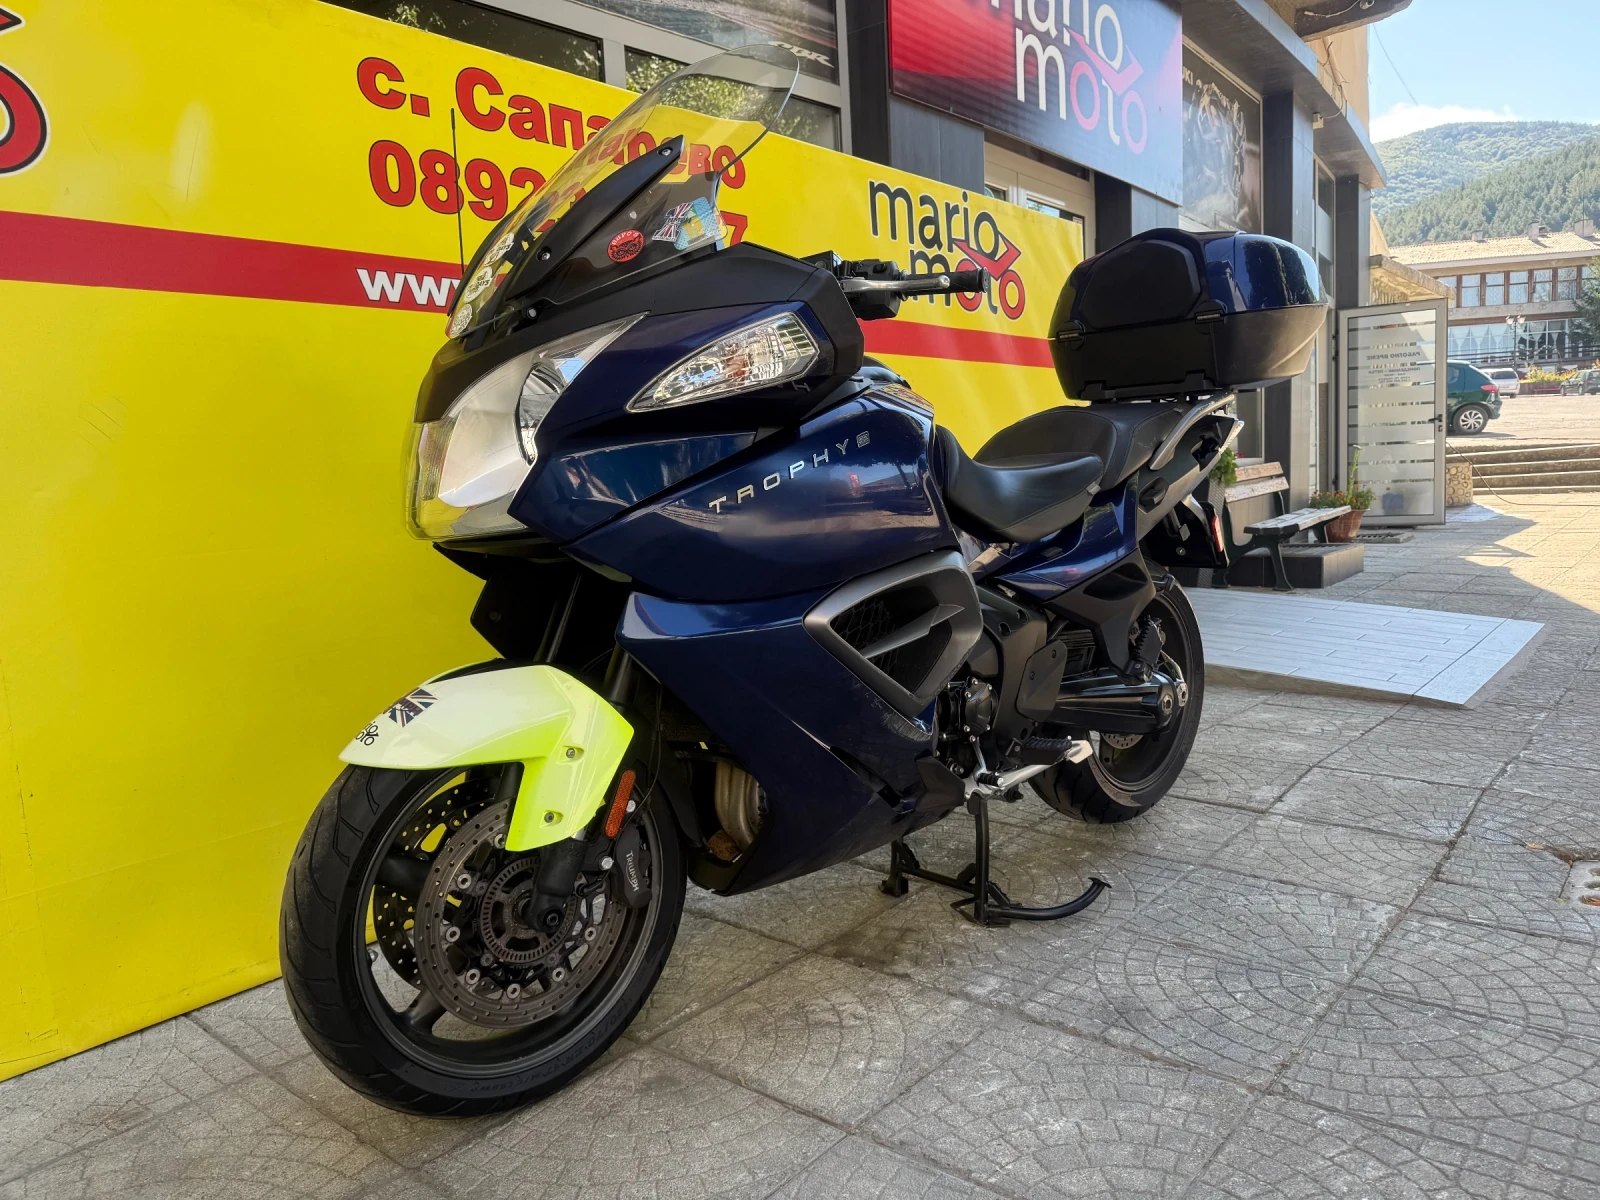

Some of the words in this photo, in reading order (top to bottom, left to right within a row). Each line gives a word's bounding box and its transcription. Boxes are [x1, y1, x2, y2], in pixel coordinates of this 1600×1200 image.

[990, 0, 1123, 71] ario
[1015, 28, 1148, 154] moto
[869, 180, 1000, 259] mario
[909, 249, 1026, 321] moto
[708, 438, 849, 514] TROPHY
[626, 849, 640, 892] TRIUMPH
